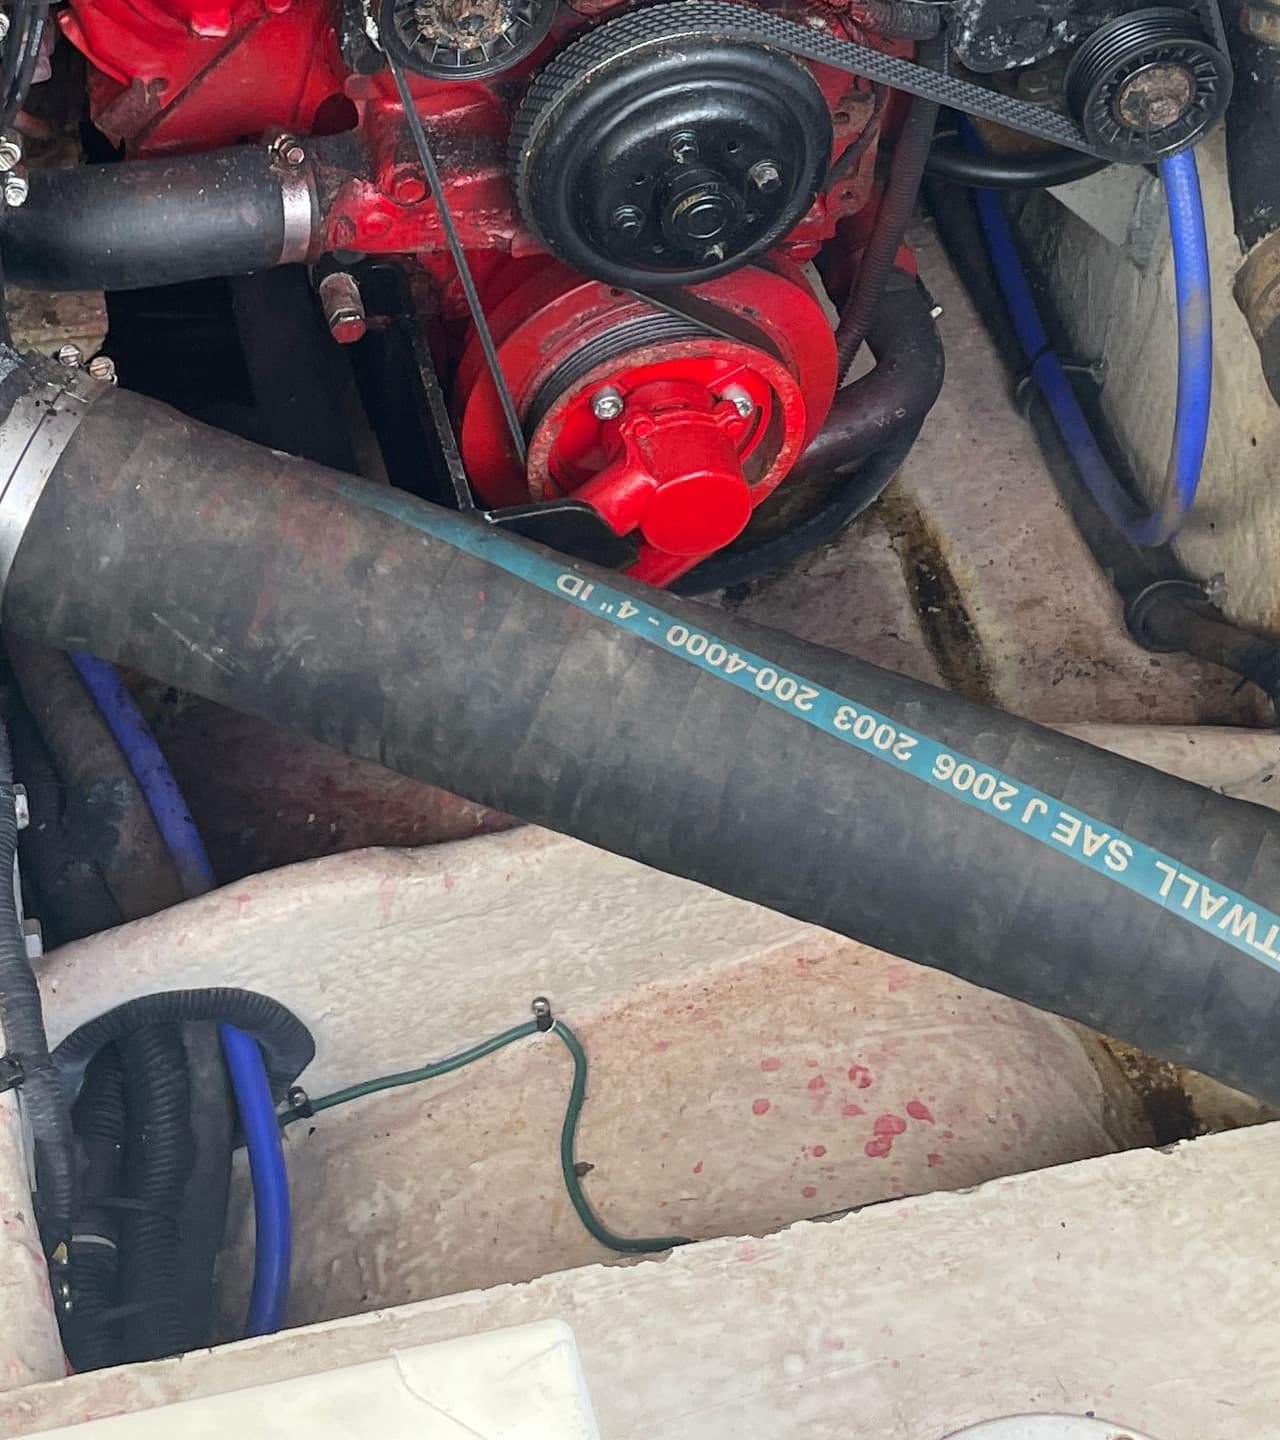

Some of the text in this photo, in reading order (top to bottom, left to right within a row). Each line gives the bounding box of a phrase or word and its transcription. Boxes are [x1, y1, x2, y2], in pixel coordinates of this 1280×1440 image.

[555, 573, 595, 601] ID
[665, 624, 820, 712] 200-4000
[832, 705, 920, 761] 2003
[931, 752, 1019, 811] 2006
[1021, 797, 1049, 824] J
[1051, 811, 1134, 872] SAE
